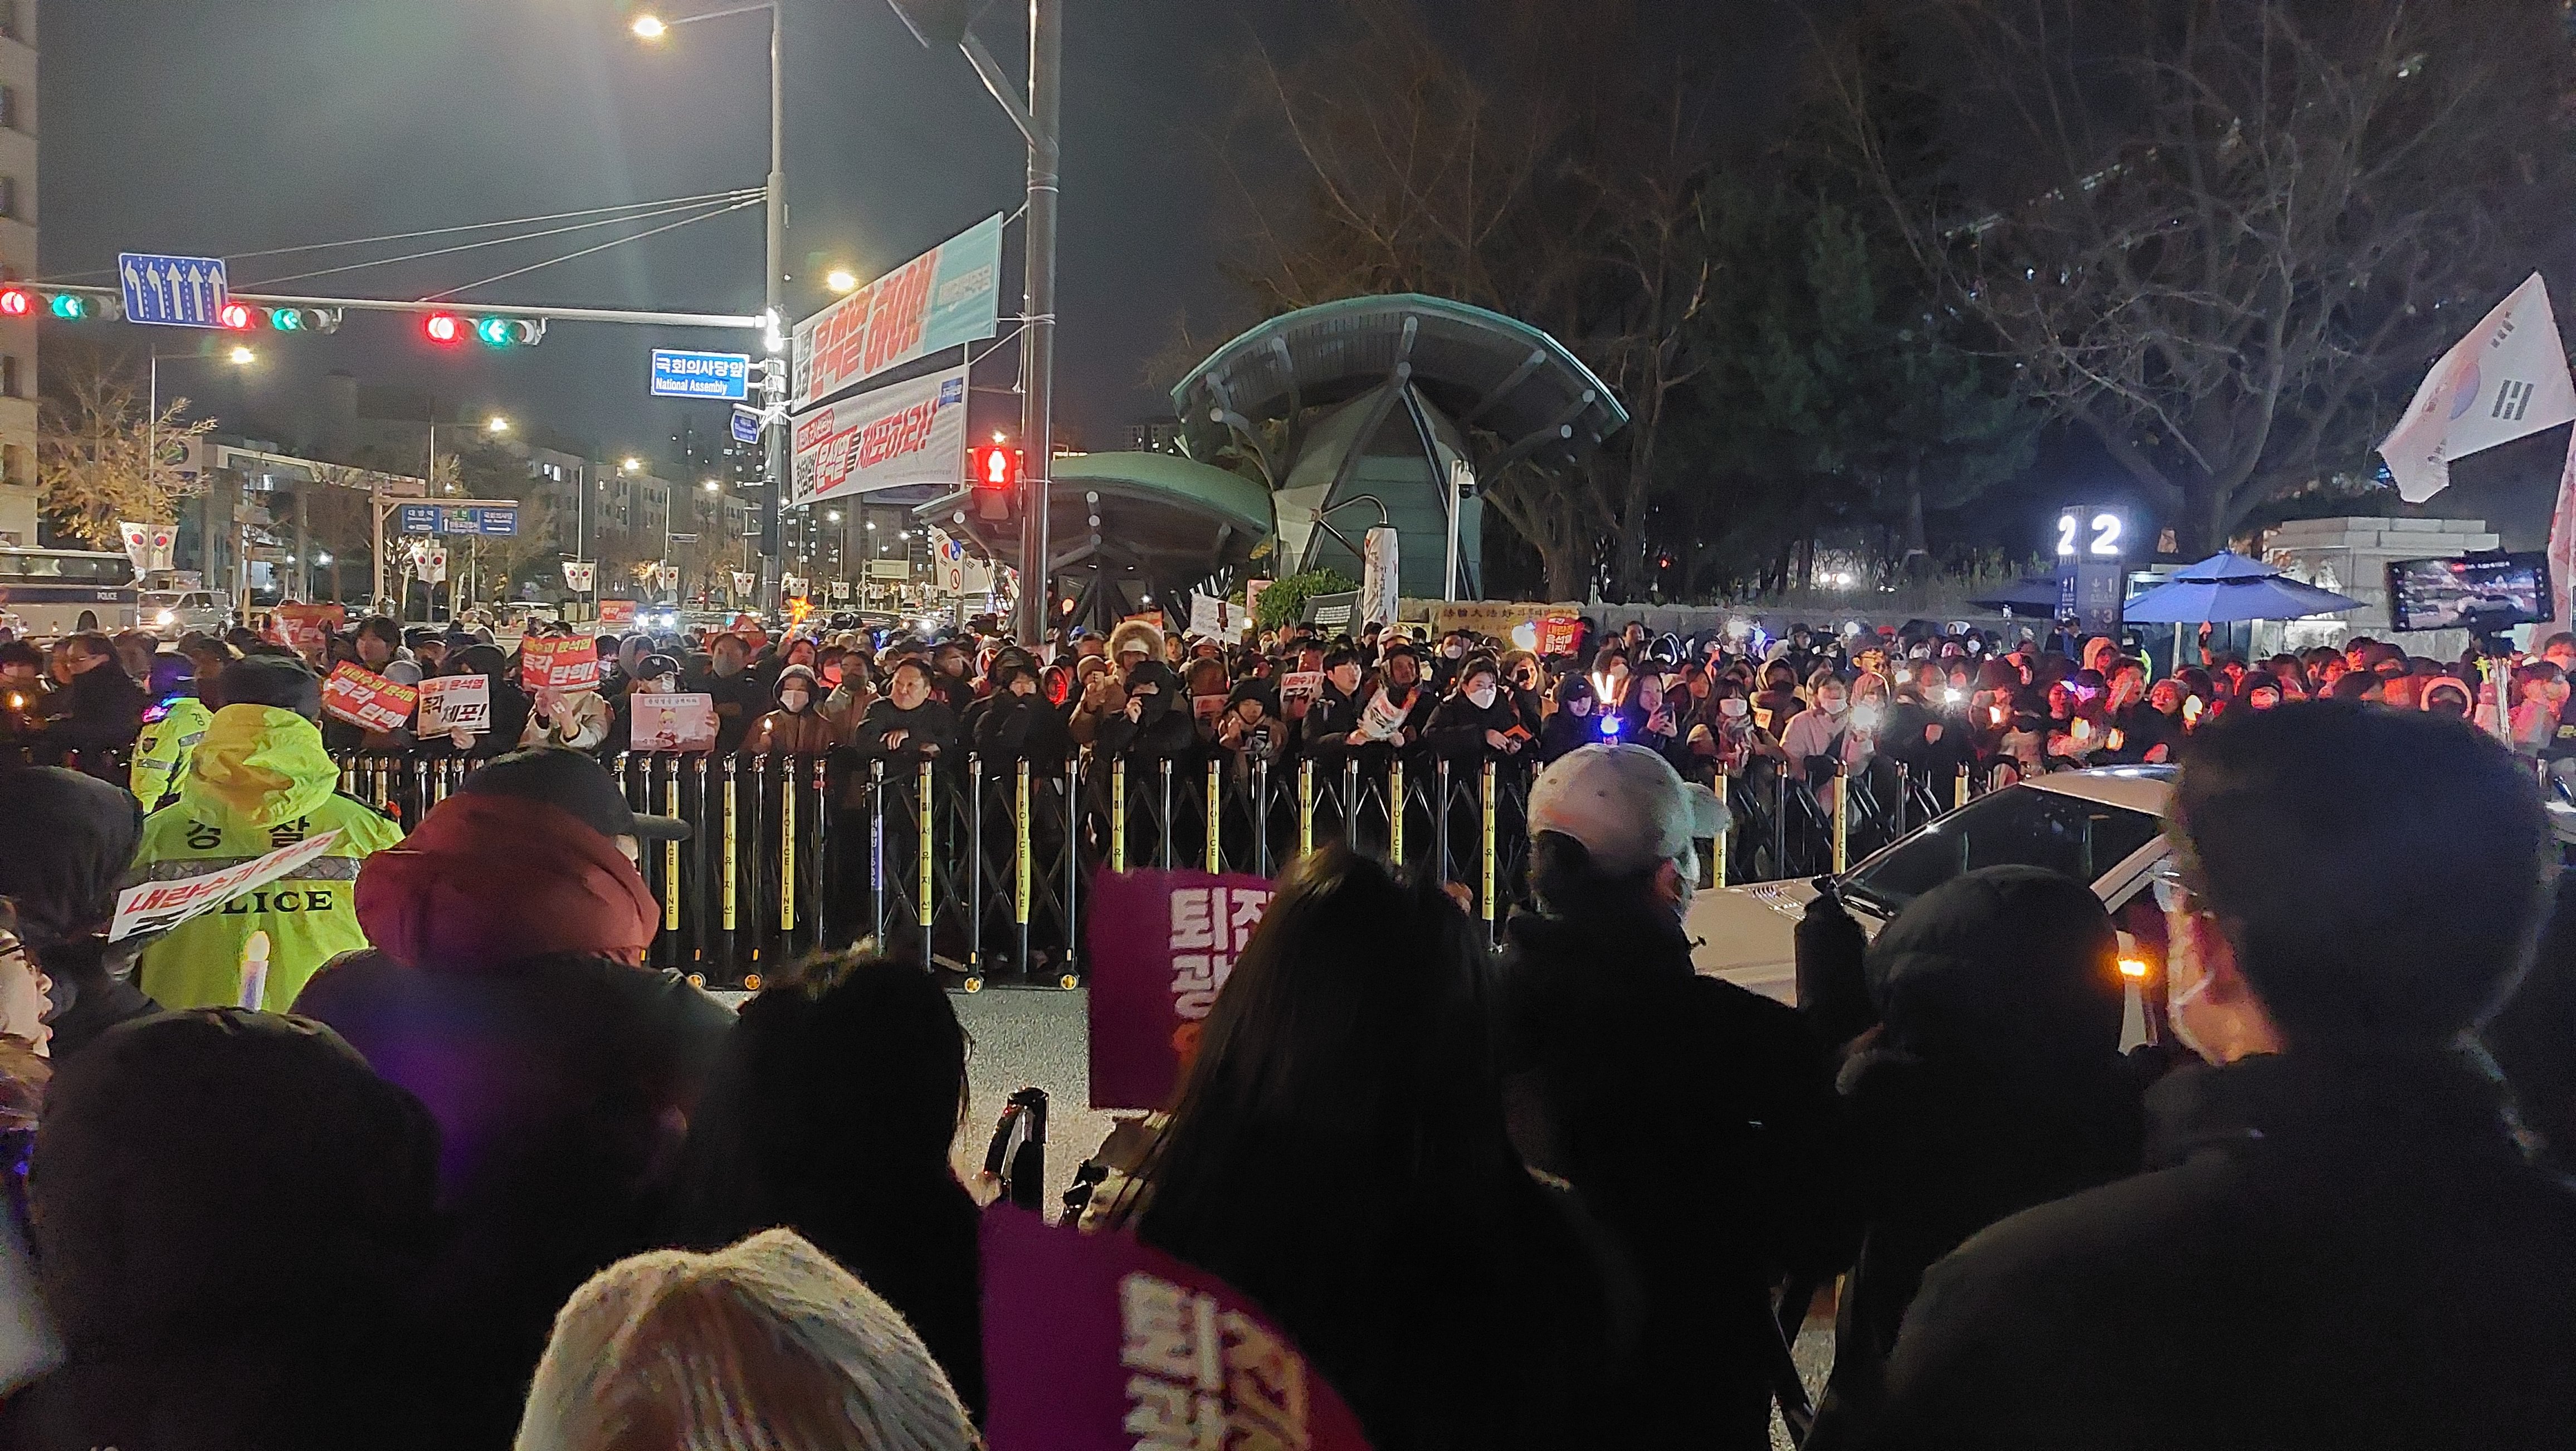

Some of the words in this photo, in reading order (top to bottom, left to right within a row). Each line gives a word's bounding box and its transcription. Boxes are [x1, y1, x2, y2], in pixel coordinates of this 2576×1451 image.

[656, 357, 744, 378] 국회의사당앞
[656, 377, 688, 391] National
[689, 379, 728, 396] Assembly
[2058, 515, 2076, 555] 2
[2090, 514, 2121, 554] 2
[96, 592, 118, 601] POLICE
[557, 638, 592, 654] 윤석열
[549, 661, 597, 684] 탄핵!
[449, 679, 485, 690] 윤석열
[421, 695, 444, 715] 즉각
[441, 704, 488, 723] 체포!
[1114, 800, 1122, 858] 질서유
[201, 890, 333, 916] LICE
